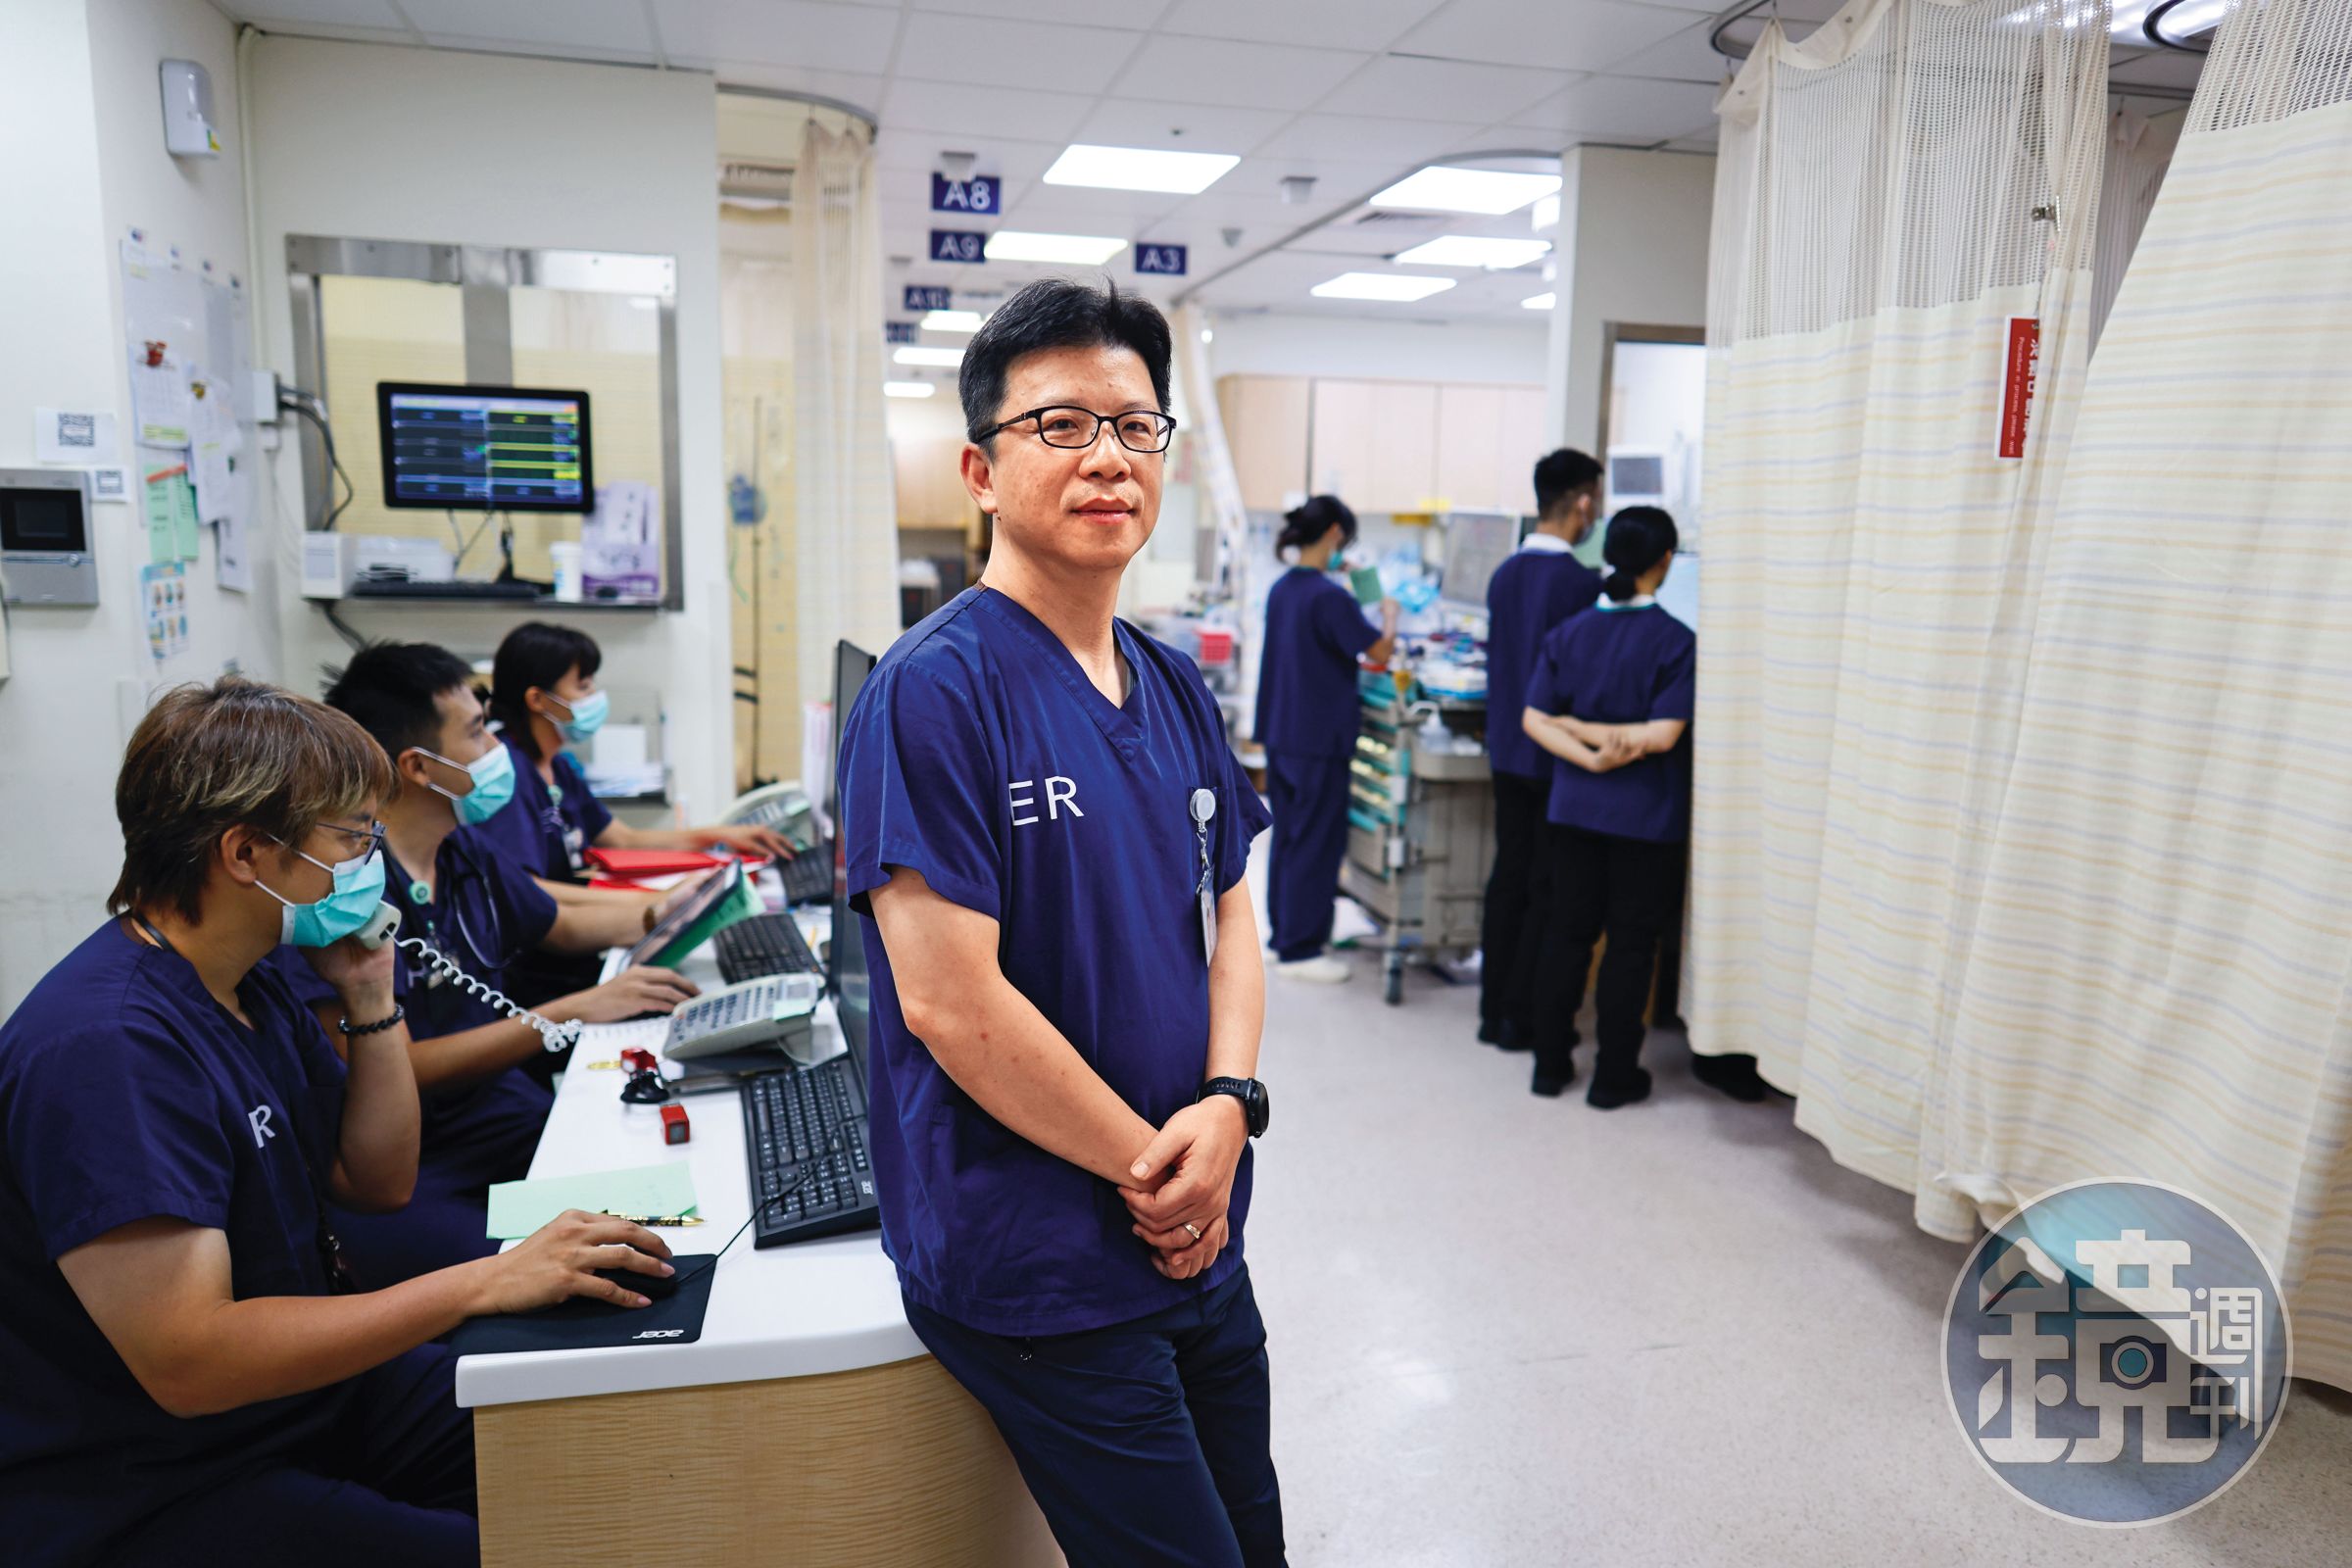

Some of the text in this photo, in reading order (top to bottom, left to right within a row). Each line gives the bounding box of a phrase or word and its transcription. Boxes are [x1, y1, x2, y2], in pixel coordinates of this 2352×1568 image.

[943, 180, 991, 211] A8
[939, 234, 980, 259] A9
[1142, 248, 1181, 271] A3
[1008, 775, 1085, 826] ER
[632, 1329, 685, 1340] acer
